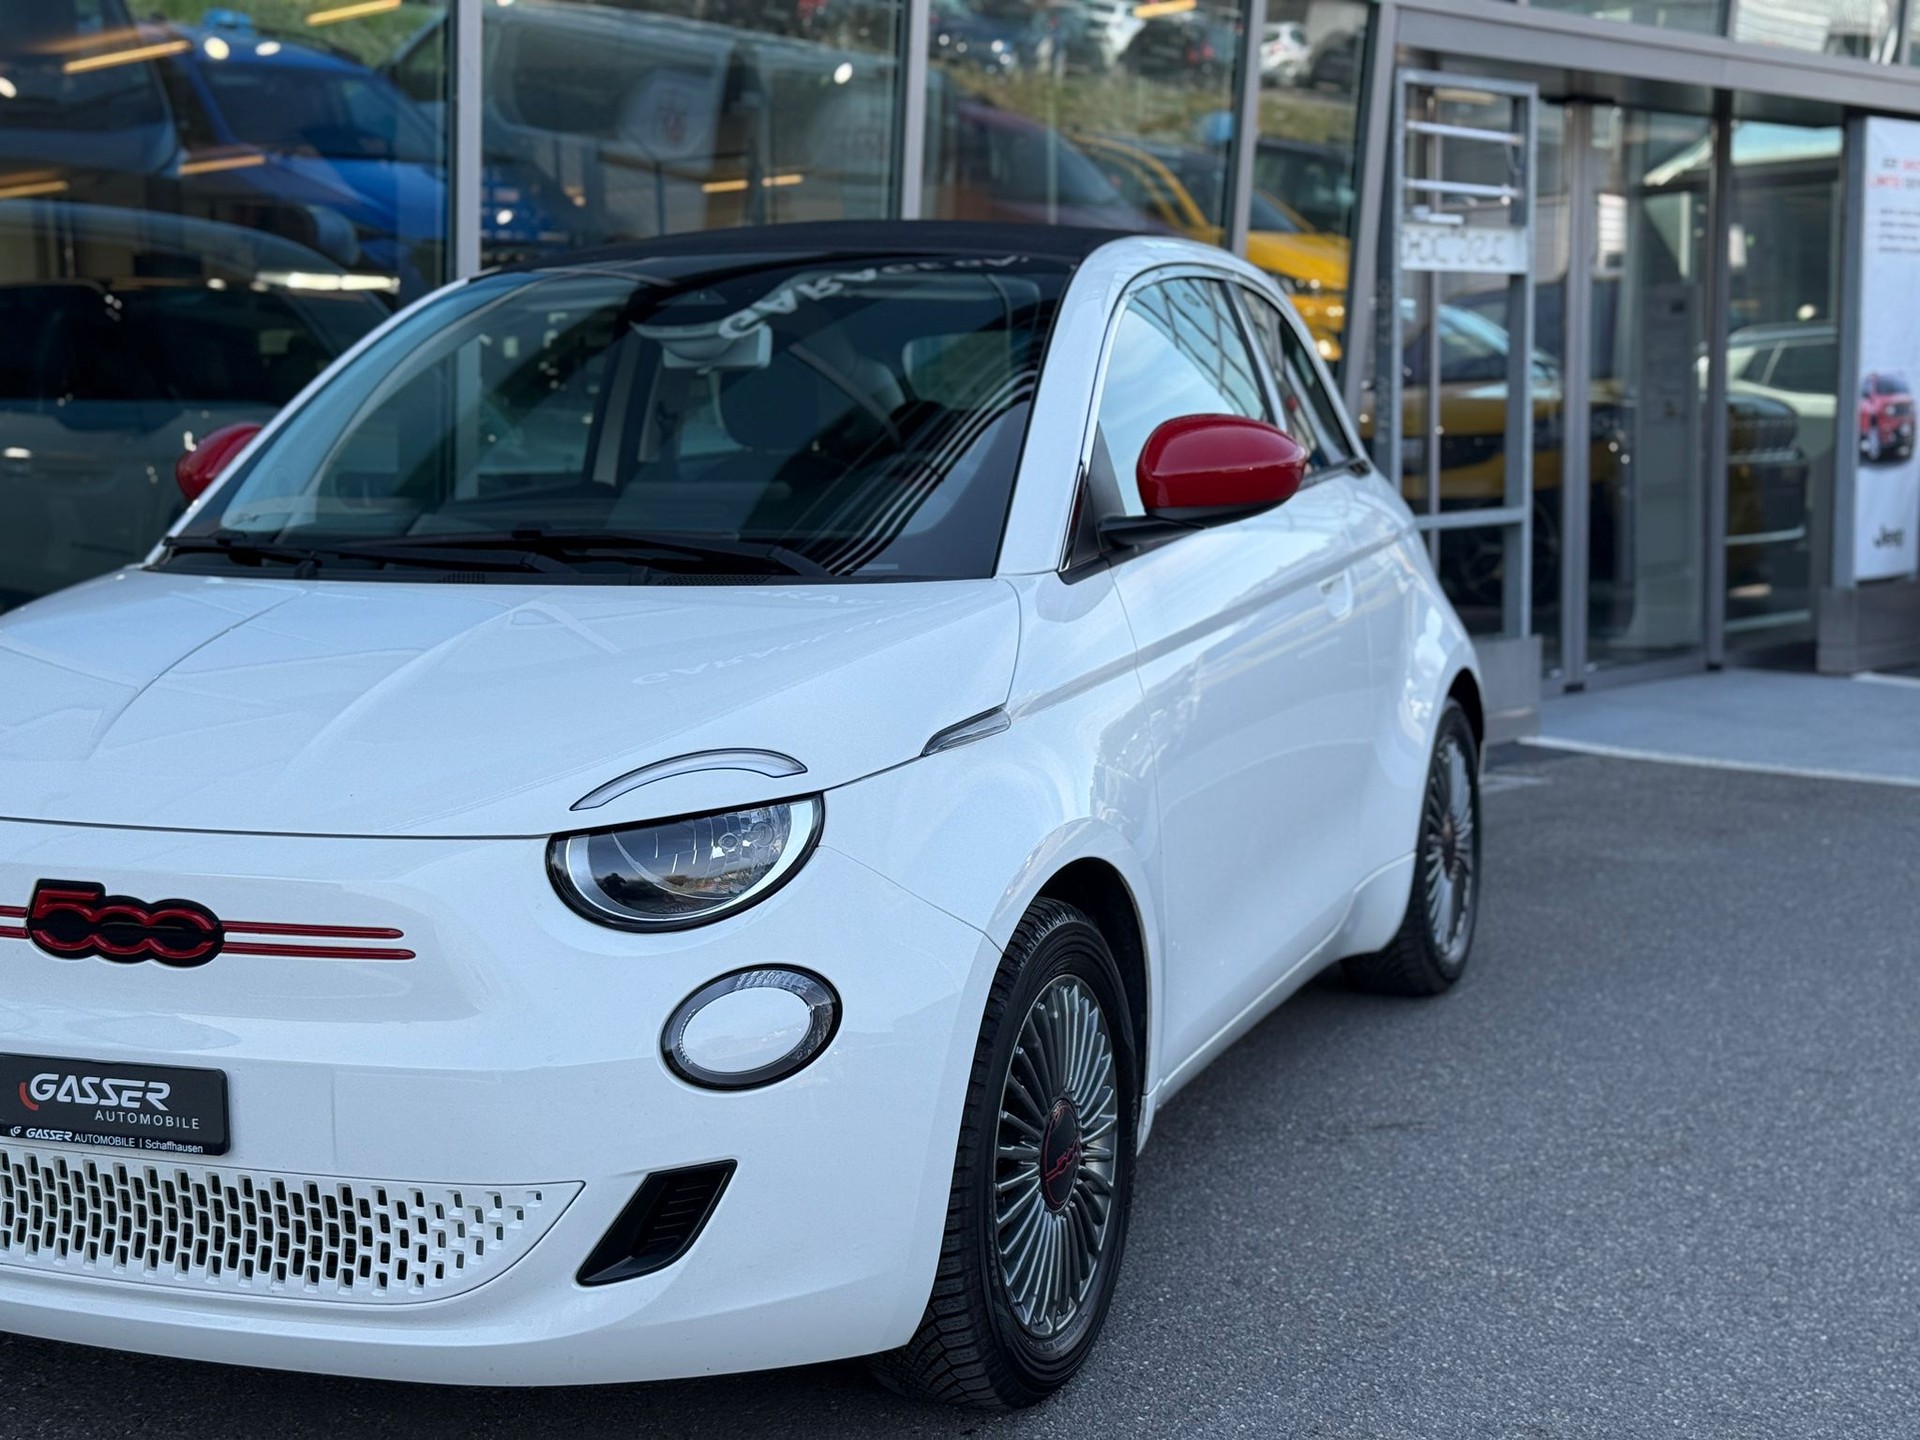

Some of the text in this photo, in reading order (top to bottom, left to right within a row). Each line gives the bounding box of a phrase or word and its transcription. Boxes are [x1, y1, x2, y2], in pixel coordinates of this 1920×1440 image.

[30, 886, 219, 960] 500
[29, 1072, 171, 1112] GASSER
[94, 1109, 200, 1130] AUTOMOBILE
[26, 1127, 73, 1142] GASSER
[74, 1133, 136, 1148] AUTOMOBILE
[145, 1138, 204, 1155] Schaffhausen
